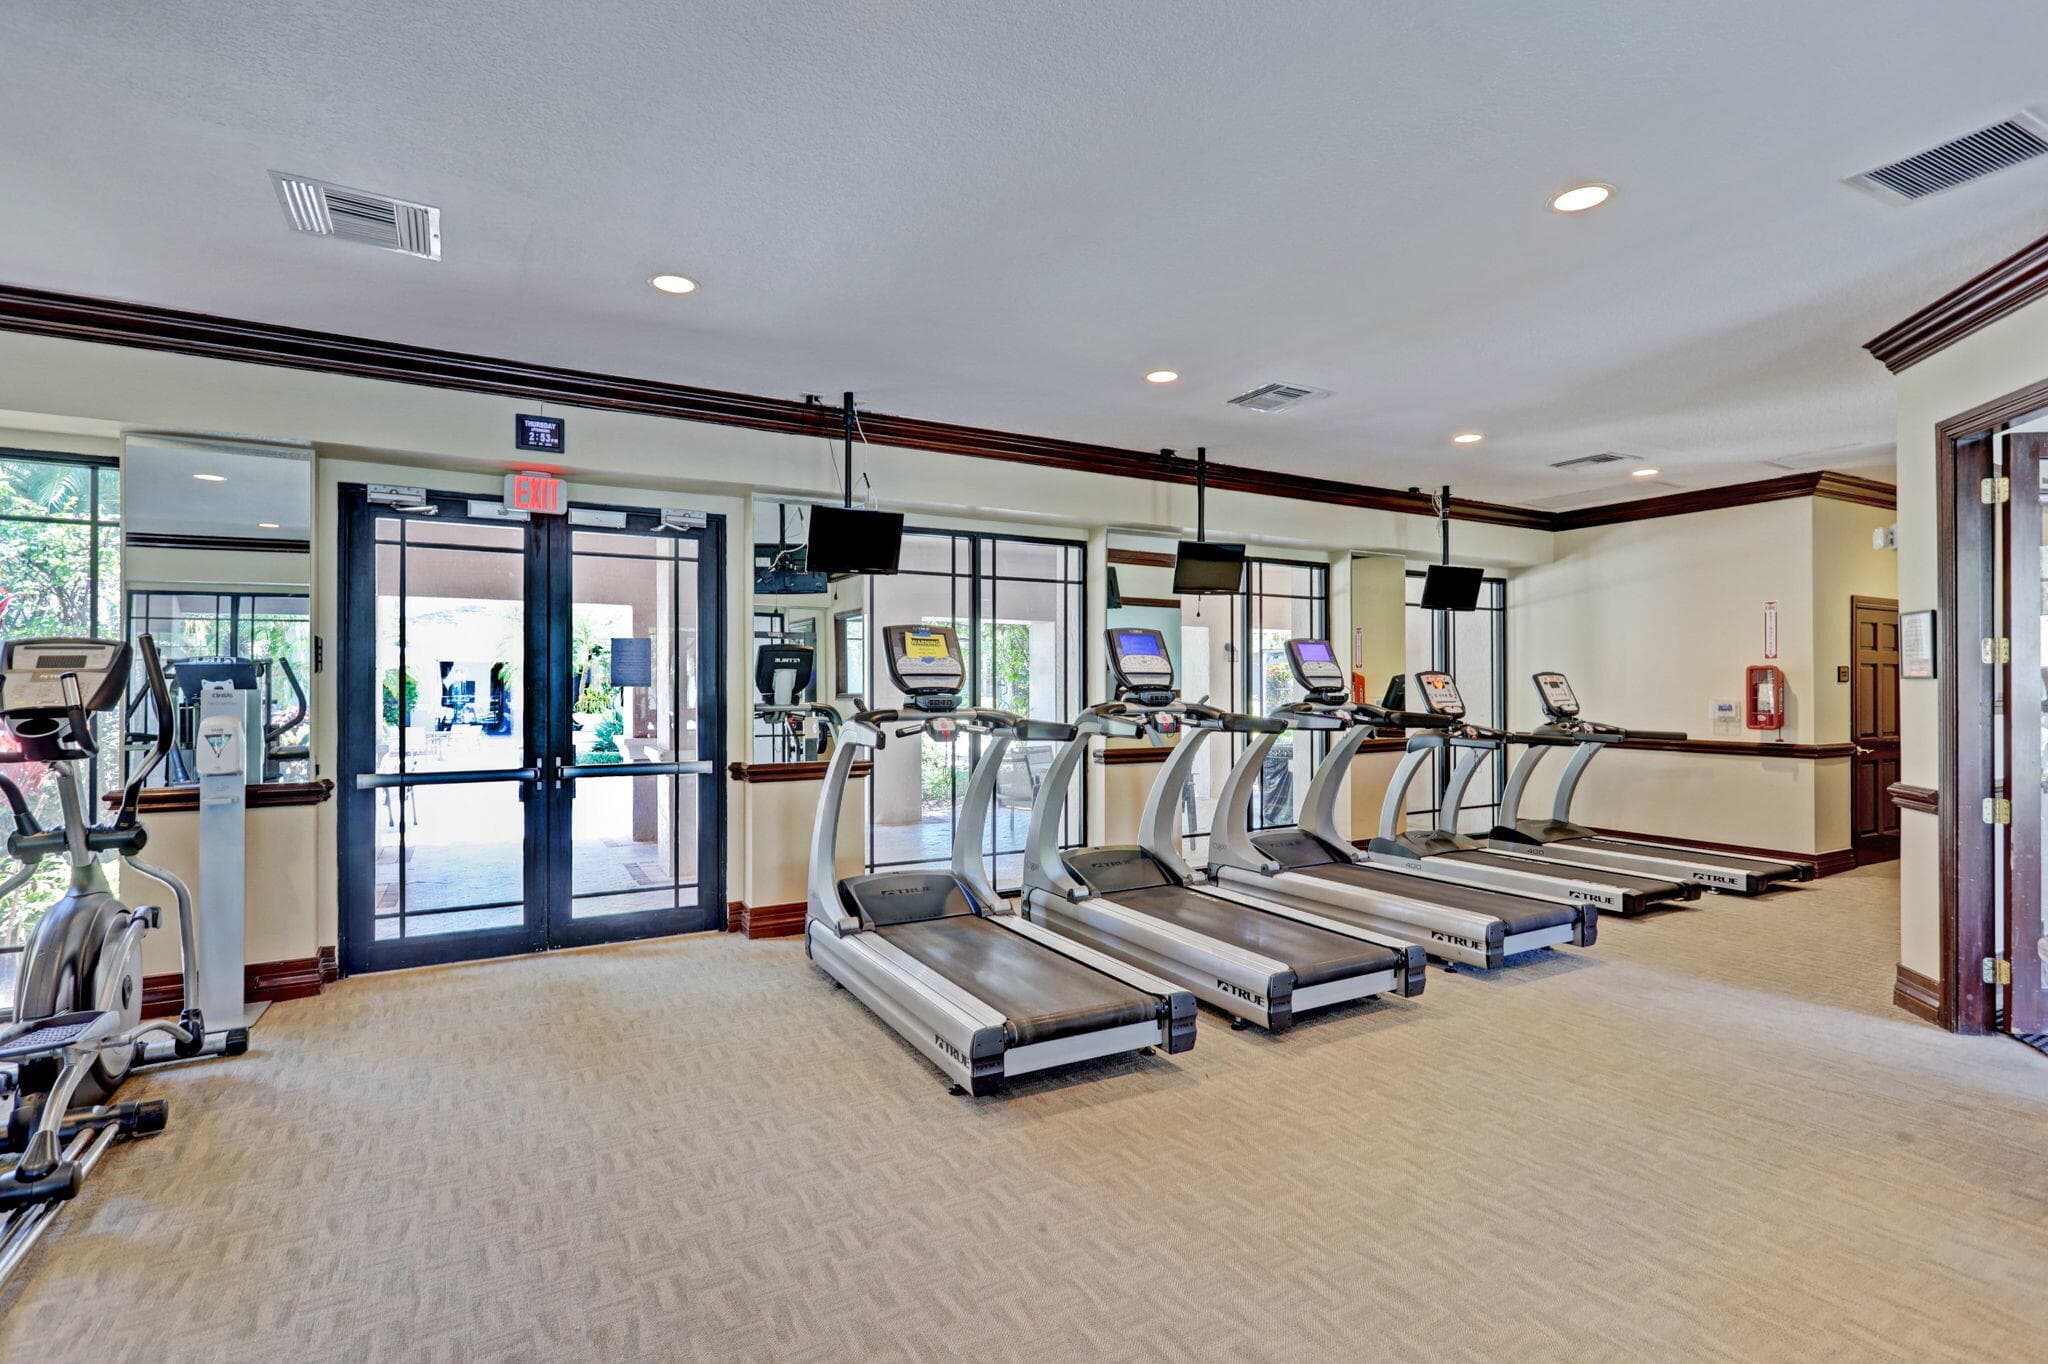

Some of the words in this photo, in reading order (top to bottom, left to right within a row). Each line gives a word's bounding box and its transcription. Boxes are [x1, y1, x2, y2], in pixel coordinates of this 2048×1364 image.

[524, 420, 556, 430] THURSDAY
[513, 475, 560, 511] EXIT
[1527, 848, 1545, 856] 400
[1405, 862, 1422, 871] 400
[1706, 874, 1738, 885] TRUE
[1581, 893, 1614, 905] TRUE
[1445, 935, 1483, 950] TRUE
[1230, 984, 1265, 1008] TRUE
[943, 1041, 970, 1069] TRUE
